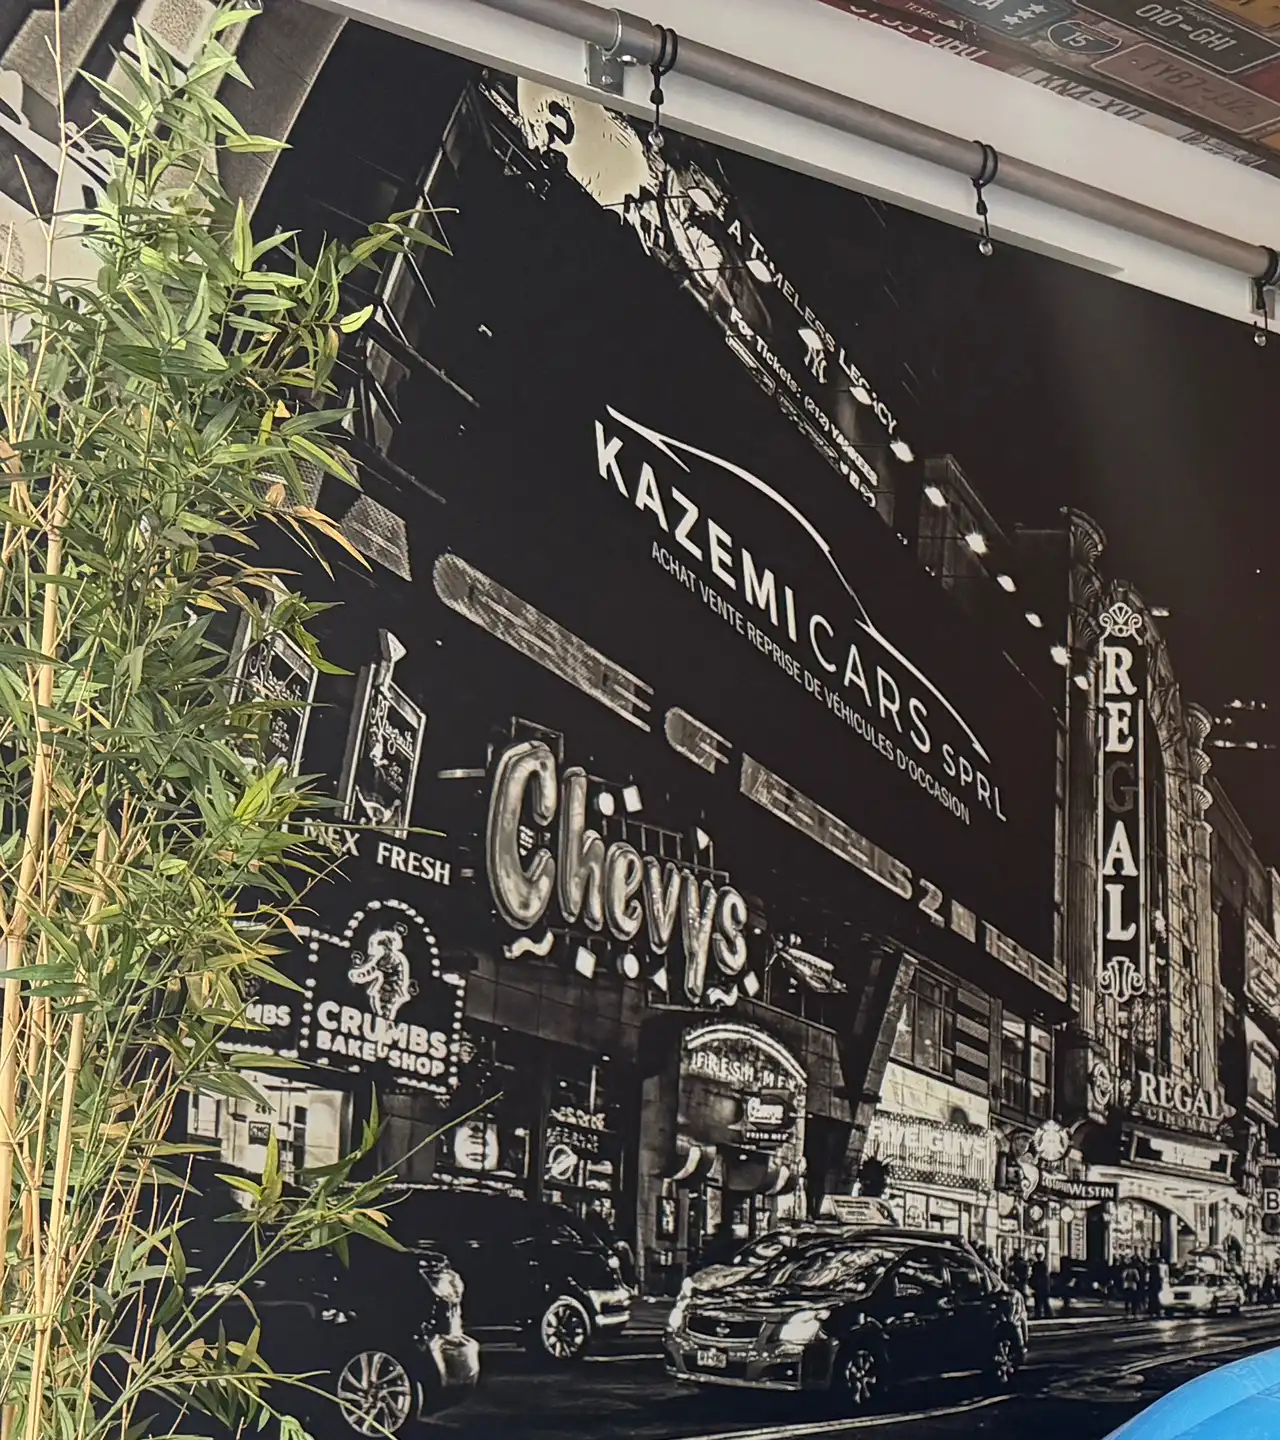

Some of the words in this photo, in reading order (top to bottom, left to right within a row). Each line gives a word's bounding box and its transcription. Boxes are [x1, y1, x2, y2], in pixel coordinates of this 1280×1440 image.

[1062, 31, 1095, 47] 15
[595, 419, 798, 643] KAZEMI
[651, 540, 699, 594] ACHAT
[699, 579, 745, 636] VENTE
[747, 624, 802, 684] REPRISE
[804, 668, 824, 702] DE
[824, 690, 894, 762] VÉHICULES
[897, 747, 971, 826] D'OCCASION
[809, 614, 932, 754] CARS
[942, 744, 1007, 822] SPRL
[1102, 645, 1138, 943] REGAL
[376, 841, 452, 886] FRESH
[485, 739, 749, 1004] Chevys
[316, 1001, 449, 1060] CRUMBS
[316, 1030, 377, 1063] BAKE
[387, 1049, 447, 1078] SHOP
[1137, 1071, 1226, 1120] REGAL
[1067, 1182, 1116, 1200] WESTIN
